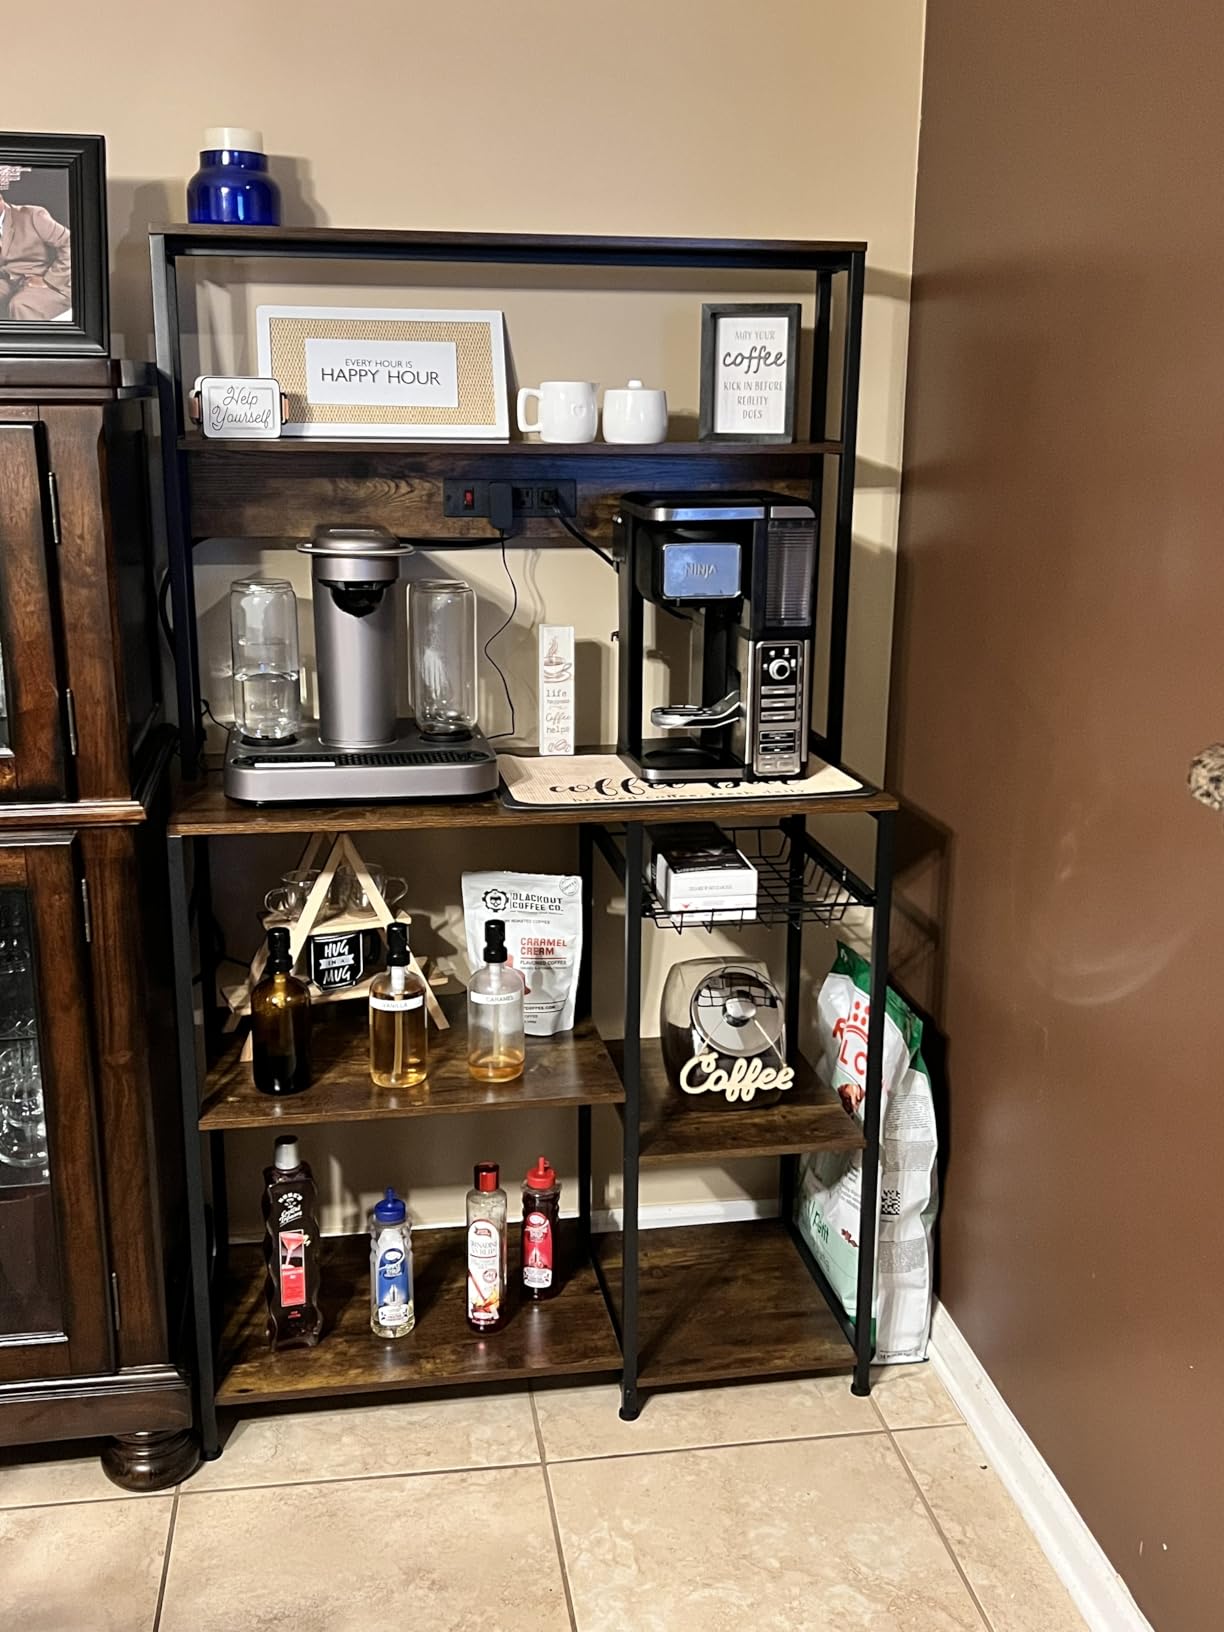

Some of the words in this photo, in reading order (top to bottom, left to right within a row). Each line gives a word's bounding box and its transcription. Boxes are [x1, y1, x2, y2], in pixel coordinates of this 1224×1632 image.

[734, 330, 752, 340] MAY
[755, 330, 777, 340] YOUR
[345, 358, 373, 367] EVERY
[375, 360, 403, 368] HOUR
[405, 361, 413, 369] IS
[722, 345, 786, 375] coffee
[321, 367, 379, 384] HAPPY
[387, 369, 441, 386] HOUR
[723, 381, 741, 391] KICK
[743, 381, 753, 391] IN
[754, 381, 783, 391] BEFORE
[223, 386, 258, 410] Help
[737, 396, 769, 406] REALITY
[212, 405, 271, 431] Yourself
[742, 409, 763, 419] DOES
[512, 902, 546, 911] COFFEE
[520, 937, 568, 947] CARAMEL
[324, 939, 349, 957] HUG
[520, 946, 554, 956] CREAM
[323, 965, 351, 985] MUG
[679, 1051, 795, 1102] Coffee
